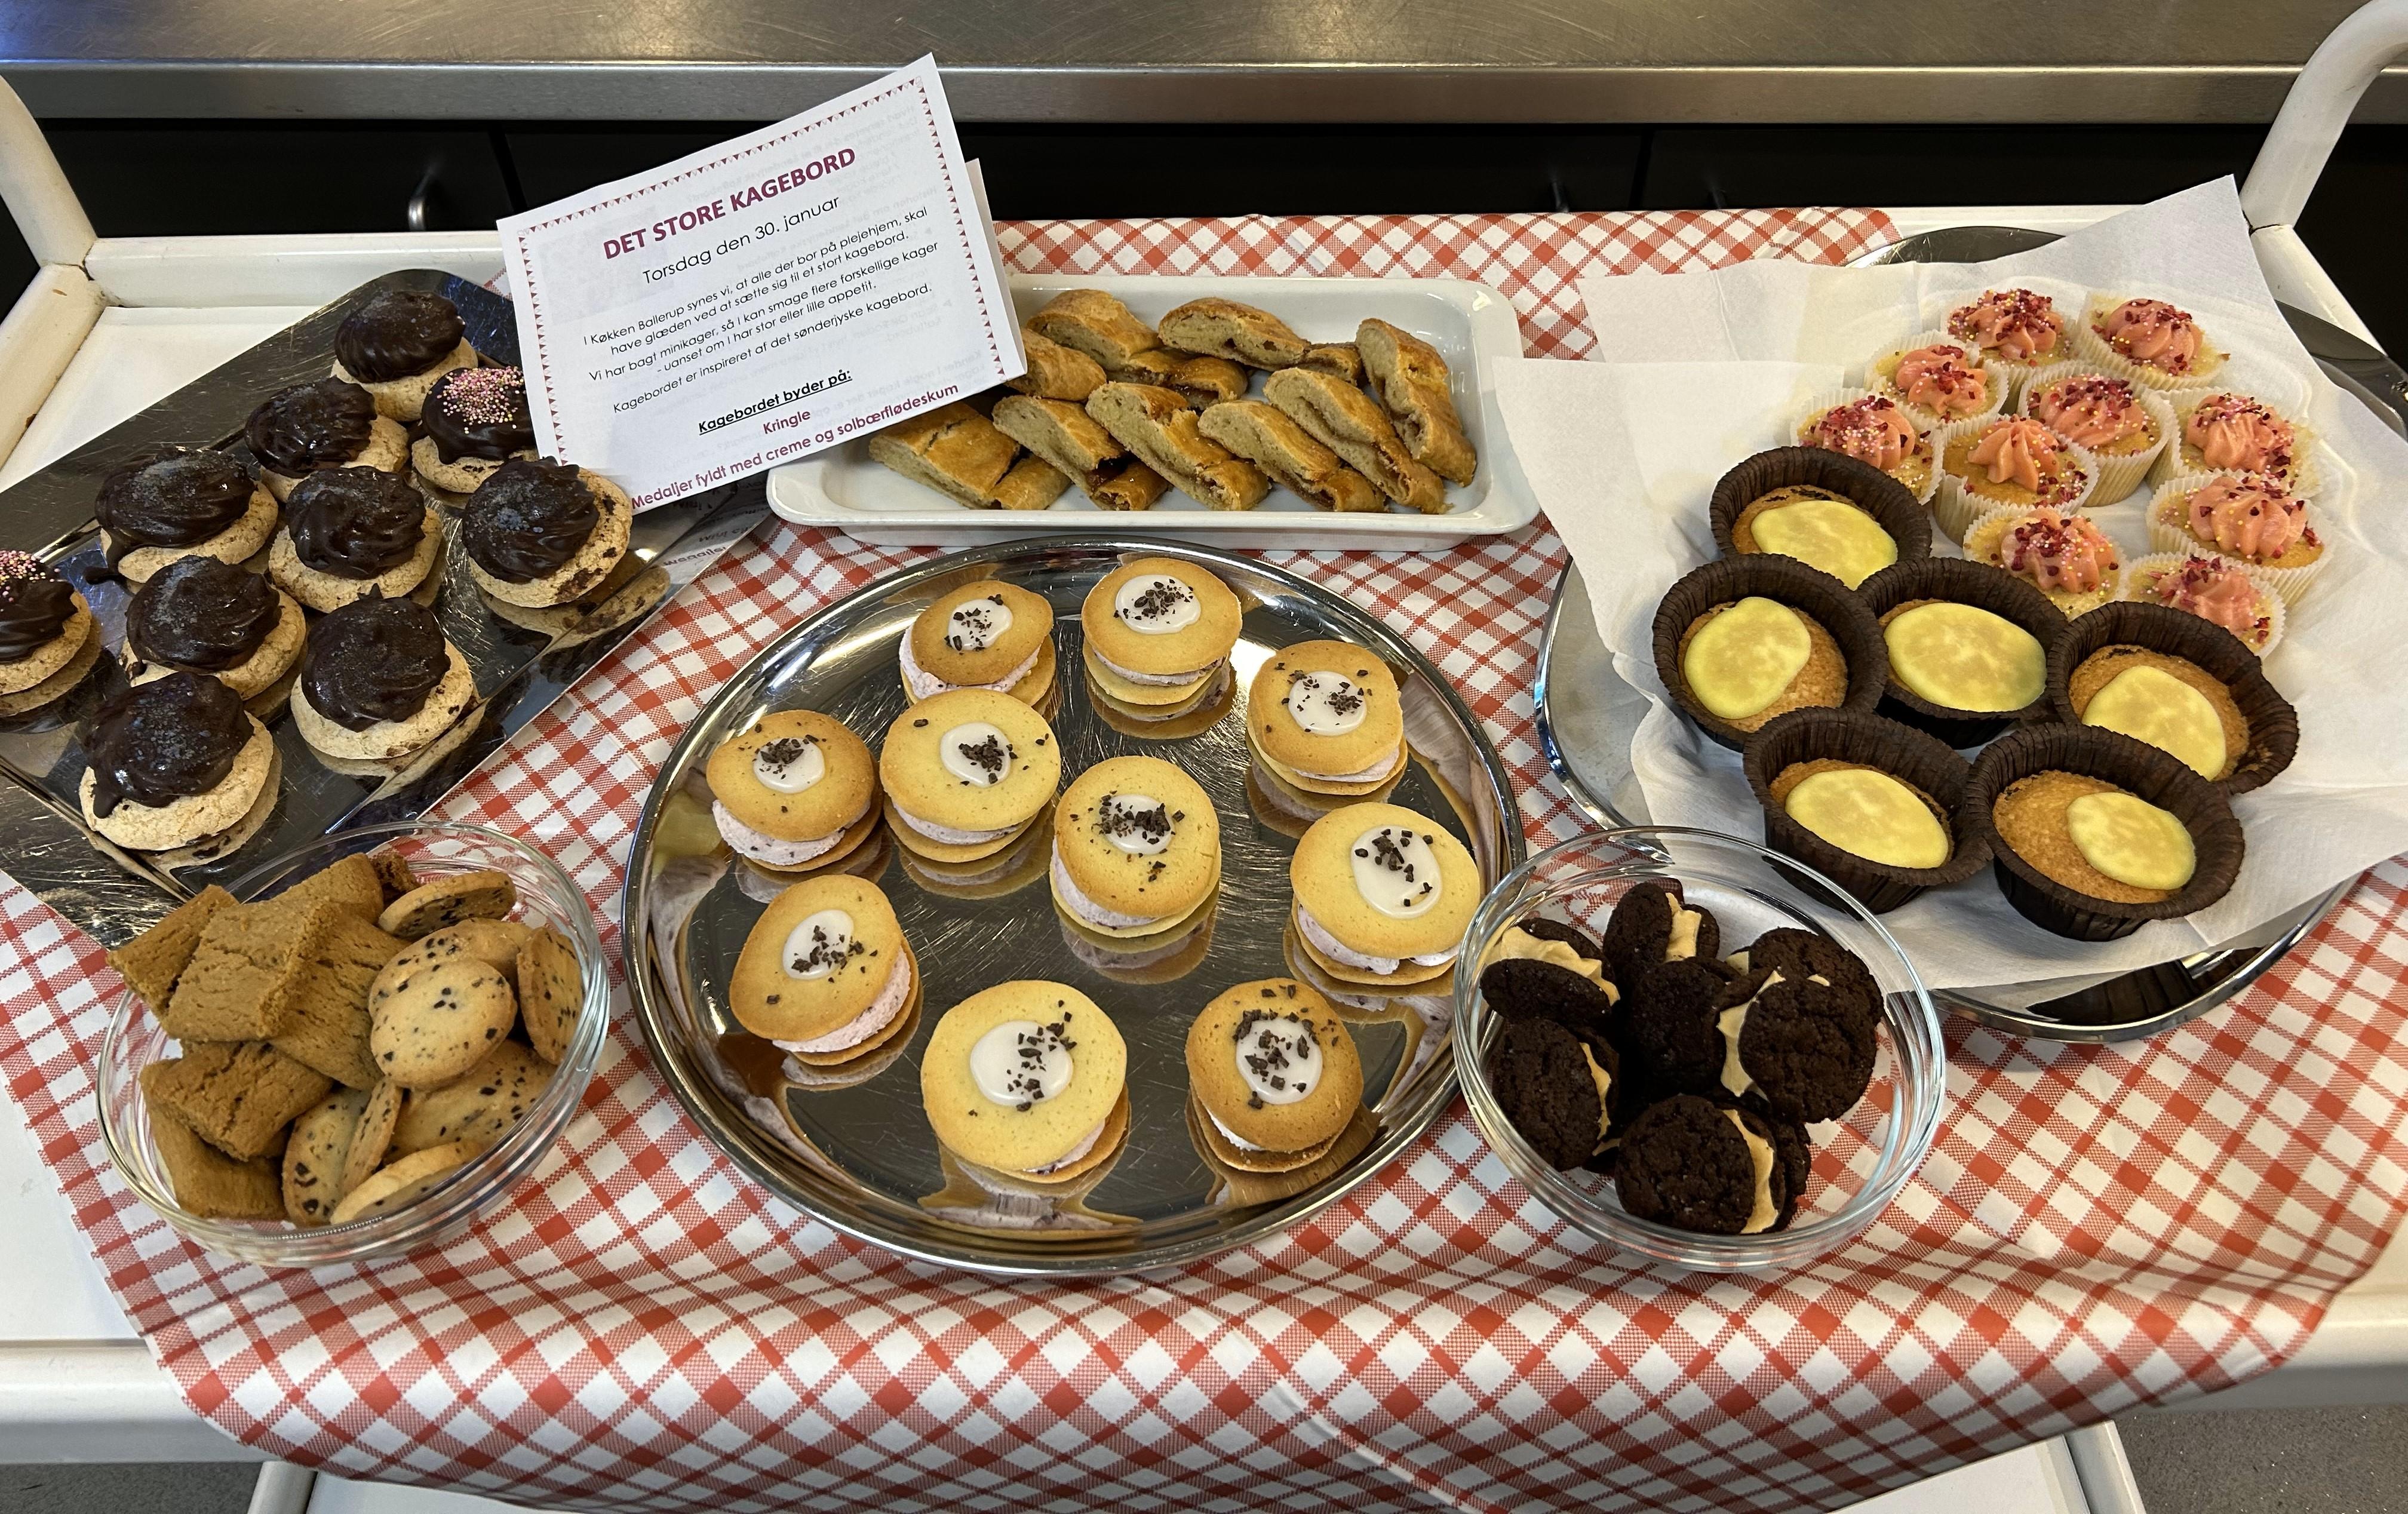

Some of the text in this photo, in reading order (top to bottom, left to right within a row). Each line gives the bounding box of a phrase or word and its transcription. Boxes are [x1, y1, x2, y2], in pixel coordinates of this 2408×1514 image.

[603, 228, 647, 260] DET
[652, 199, 727, 242] STORE
[729, 148, 856, 213] KAGEBORD
[642, 196, 839, 284] Torsdag den 30. januar
[583, 206, 927, 346] I Køkken Ballerup synes vi, at alle der bor på plejehjem, skal
[588, 242, 938, 381] Vi har bagt minikager, så I kan smage flere forskellige kager
[610, 230, 909, 355] have glæden ved at sætte sig til et stort kagebord.
[664, 347, 702, 371] uanset
[705, 340, 725, 354] om
[727, 335, 731, 345] I
[733, 328, 753, 343] har
[755, 318, 777, 334] stor
[779, 307, 804, 324] eller
[806, 300, 825, 314] lille
[828, 280, 877, 305] appetit.
[613, 282, 932, 414] Kagebordet er inspireret af det sønderjyske kagebord.
[698, 369, 852, 435] Kagebordet byder på:
[631, 480, 693, 509] Medaljer
[695, 465, 727, 487] fyldt
[729, 452, 763, 475] med
[766, 438, 812, 461] creme
[815, 429, 834, 443] og
[837, 385, 959, 435] solbærflødeskum
[763, 410, 811, 435] Kringle
